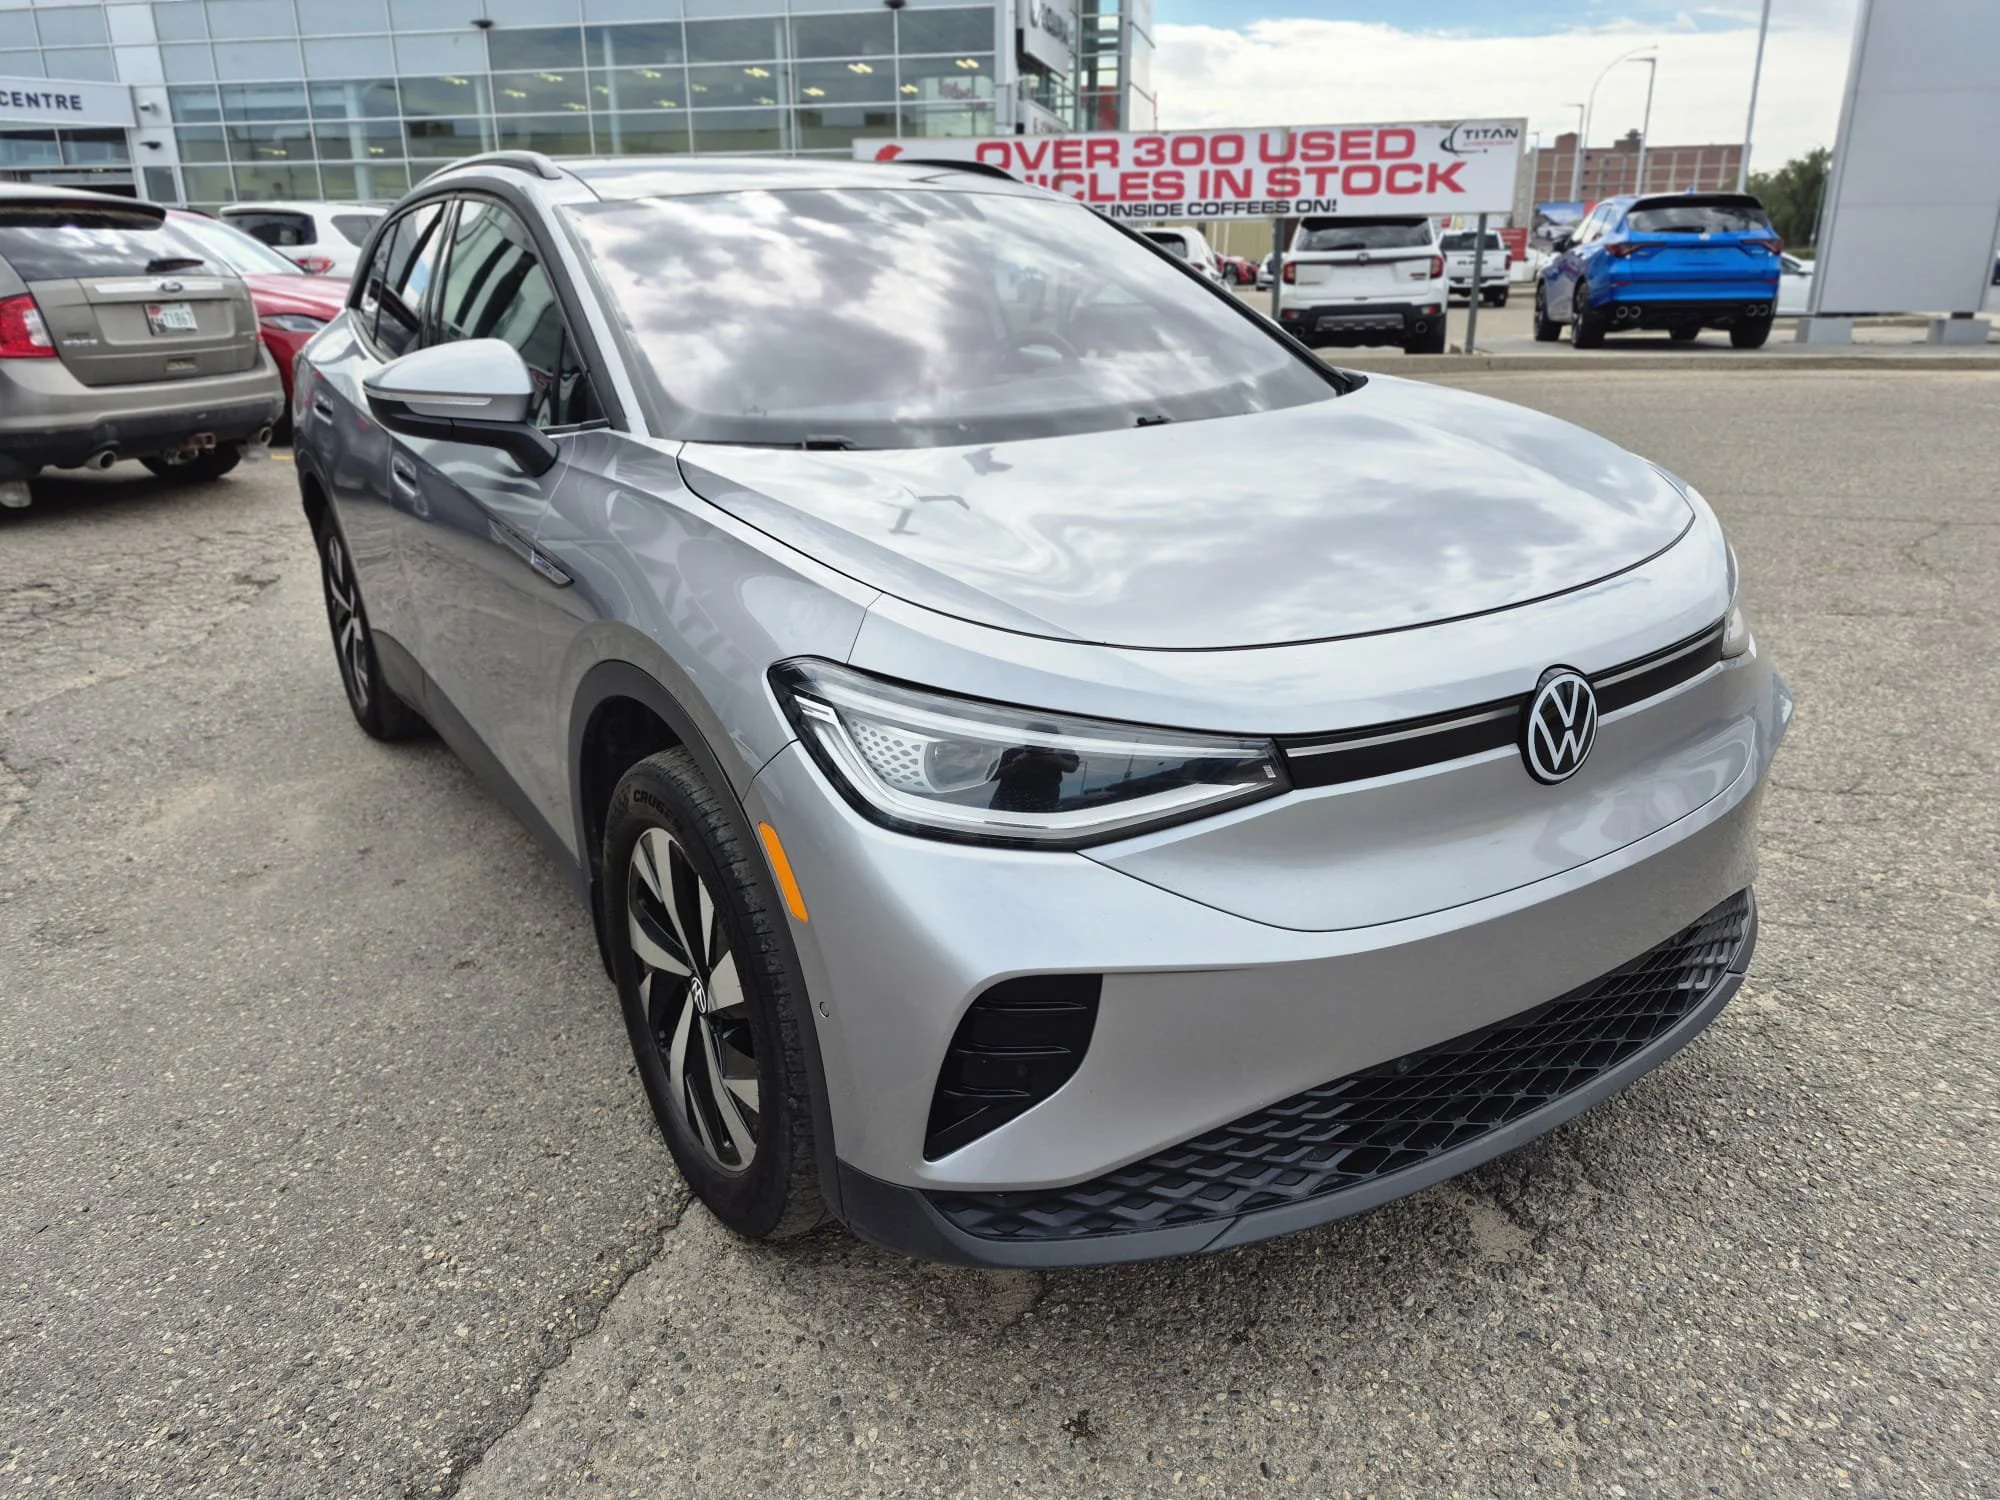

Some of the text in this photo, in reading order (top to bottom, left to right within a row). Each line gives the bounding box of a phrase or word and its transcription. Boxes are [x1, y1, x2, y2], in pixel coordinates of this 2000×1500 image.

[0, 91, 83, 110] CENTRE
[1463, 128, 1519, 140] TITAN
[976, 128, 1416, 170] OVER 300 USED
[1198, 167, 1253, 200] IN
[1265, 161, 1467, 200] STOCK
[1110, 202, 1183, 218] INSIDE
[1187, 199, 1290, 216] COFFEES
[1295, 198, 1337, 213] ON!
